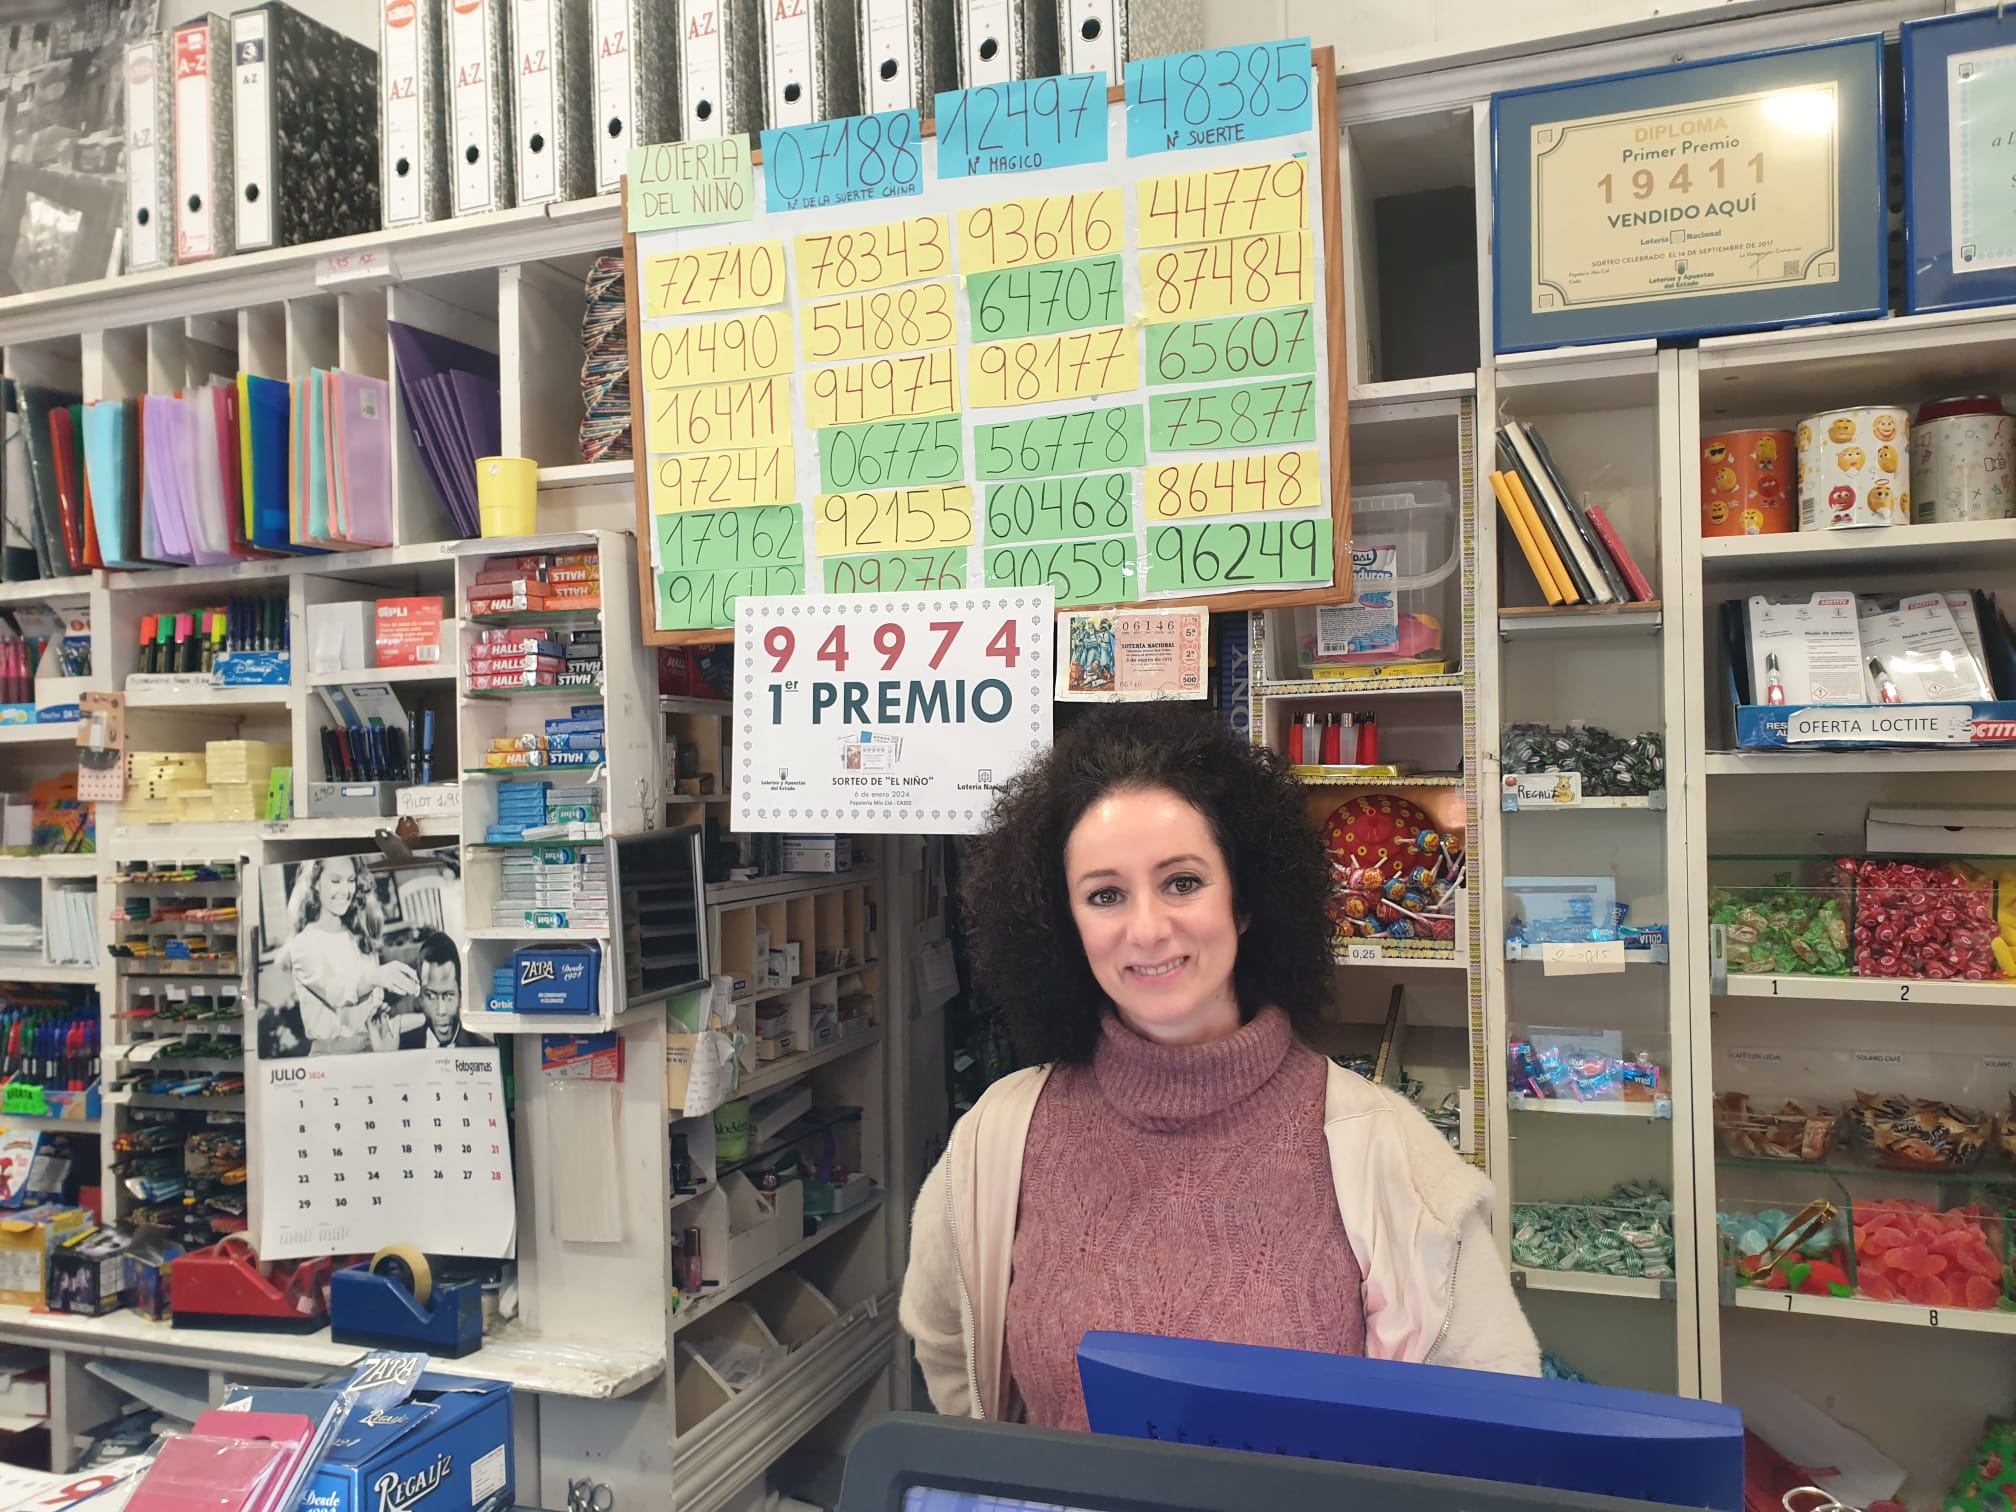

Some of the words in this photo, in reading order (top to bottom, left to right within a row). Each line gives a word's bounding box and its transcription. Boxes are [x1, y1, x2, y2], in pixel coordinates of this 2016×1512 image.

[688, 12, 717, 40] A-Z
[600, 31, 627, 59] A-Z
[179, 54, 206, 74] A-Z
[456, 62, 484, 88] A-Z
[521, 50, 548, 76] A-Z
[389, 76, 416, 101] A-Z
[1137, 43, 1309, 130] 48385
[941, 75, 1095, 156] 12497
[1186, 123, 1246, 147] SUERTE
[1634, 115, 1729, 143] DIPLOMA
[773, 112, 918, 201] 07188
[989, 152, 1043, 173] MAGICO
[1622, 145, 1677, 164] Primer
[1682, 136, 1740, 156] Premio
[1597, 151, 1767, 205] 19411
[642, 191, 681, 219] DEL
[835, 188, 875, 204] SUERTE
[882, 182, 916, 198] CHINA
[1150, 159, 1306, 240] 44779
[1607, 204, 1701, 229] VENDIDO
[1704, 192, 1757, 218] AQUÍ
[967, 190, 1113, 265] 93616
[804, 216, 945, 289] 78343
[1622, 253, 1665, 263] CELEBRADO
[1699, 243, 1744, 255] SEPTIEMBRE
[1758, 240, 1774, 248] 2017
[655, 245, 774, 309] 72710
[1155, 230, 1304, 315] 87484
[980, 260, 1118, 333] 64707
[812, 283, 954, 357] 54883
[650, 313, 779, 380] 01490
[1157, 309, 1309, 380] 65607
[979, 328, 1126, 401] 98177
[813, 347, 955, 424] 94974
[656, 377, 775, 445] 16411
[1163, 380, 1314, 448] 75877
[829, 417, 960, 488] 06775
[986, 406, 1129, 474] 56778
[659, 446, 781, 508] 97241
[1158, 451, 1302, 517] 86448
[824, 485, 973, 547] 92155
[989, 473, 1128, 538] 60468
[665, 505, 797, 567] 17962
[1156, 519, 1317, 585] 96249
[552, 569, 586, 582] HALLS
[992, 538, 1126, 600] 90659
[555, 585, 588, 598] HALLS
[1122, 620, 1175, 632] 06146
[491, 642, 525, 655] HALLS
[763, 619, 1021, 673] 94974
[491, 658, 525, 671] HALLS
[568, 661, 601, 672] HALLS
[491, 673, 525, 686] HALLS
[557, 673, 592, 685] HALLS
[812, 678, 1013, 725] PREMIO
[1799, 719, 1862, 734] OFERTA
[1872, 717, 1939, 732] LOCTITE
[550, 753, 584, 764] HALLS
[832, 776, 868, 787] SORTEO
[871, 776, 883, 787] DE
[854, 790, 860, 799] 6
[861, 790, 870, 799] de
[871, 791, 890, 799] enero
[892, 790, 911, 799] 2024
[402, 793, 432, 807] PILOT
[1352, 948, 1376, 960] 0,25
[521, 960, 555, 985] ZARA
[1772, 979, 1778, 995] 1
[1900, 985, 1910, 1001] 2
[490, 1000, 514, 1009] Orbit
[270, 1067, 306, 1084] JULIO
[455, 1059, 493, 1075] Fotogramas
[299, 1100, 304, 1109] 1
[333, 1097, 339, 1106] 2
[367, 1096, 374, 1105] 3
[402, 1094, 409, 1103] 4
[435, 1093, 441, 1101] 5
[463, 1093, 469, 1101] 6
[488, 1093, 493, 1101] 7
[299, 1125, 306, 1134] 8
[334, 1123, 341, 1132] 9
[364, 1121, 376, 1130] 10
[402, 1119, 411, 1128] 11
[433, 1119, 442, 1127] 12
[462, 1119, 471, 1127] 13
[488, 1119, 497, 1128] 14
[298, 1150, 308, 1159] 15
[332, 1148, 343, 1157] 16
[367, 1146, 377, 1155] 17
[401, 1144, 412, 1154] 18
[433, 1144, 443, 1153] 19
[461, 1144, 472, 1153] 20
[491, 1145, 500, 1154] 21
[298, 1175, 310, 1184] 22
[333, 1173, 345, 1182] 23
[367, 1171, 380, 1181] 24
[402, 1170, 414, 1179] 25
[433, 1171, 444, 1180] 26
[462, 1171, 473, 1180] 27
[491, 1171, 501, 1181] 28
[298, 1200, 311, 1209] 29
[335, 1198, 347, 1207] 30
[372, 1197, 382, 1206] 31
[1784, 1295, 1793, 1311] 7
[1929, 1310, 1939, 1326] 8
[347, 1357, 418, 1392] ZARA
[302, 1489, 341, 1508] Desde
